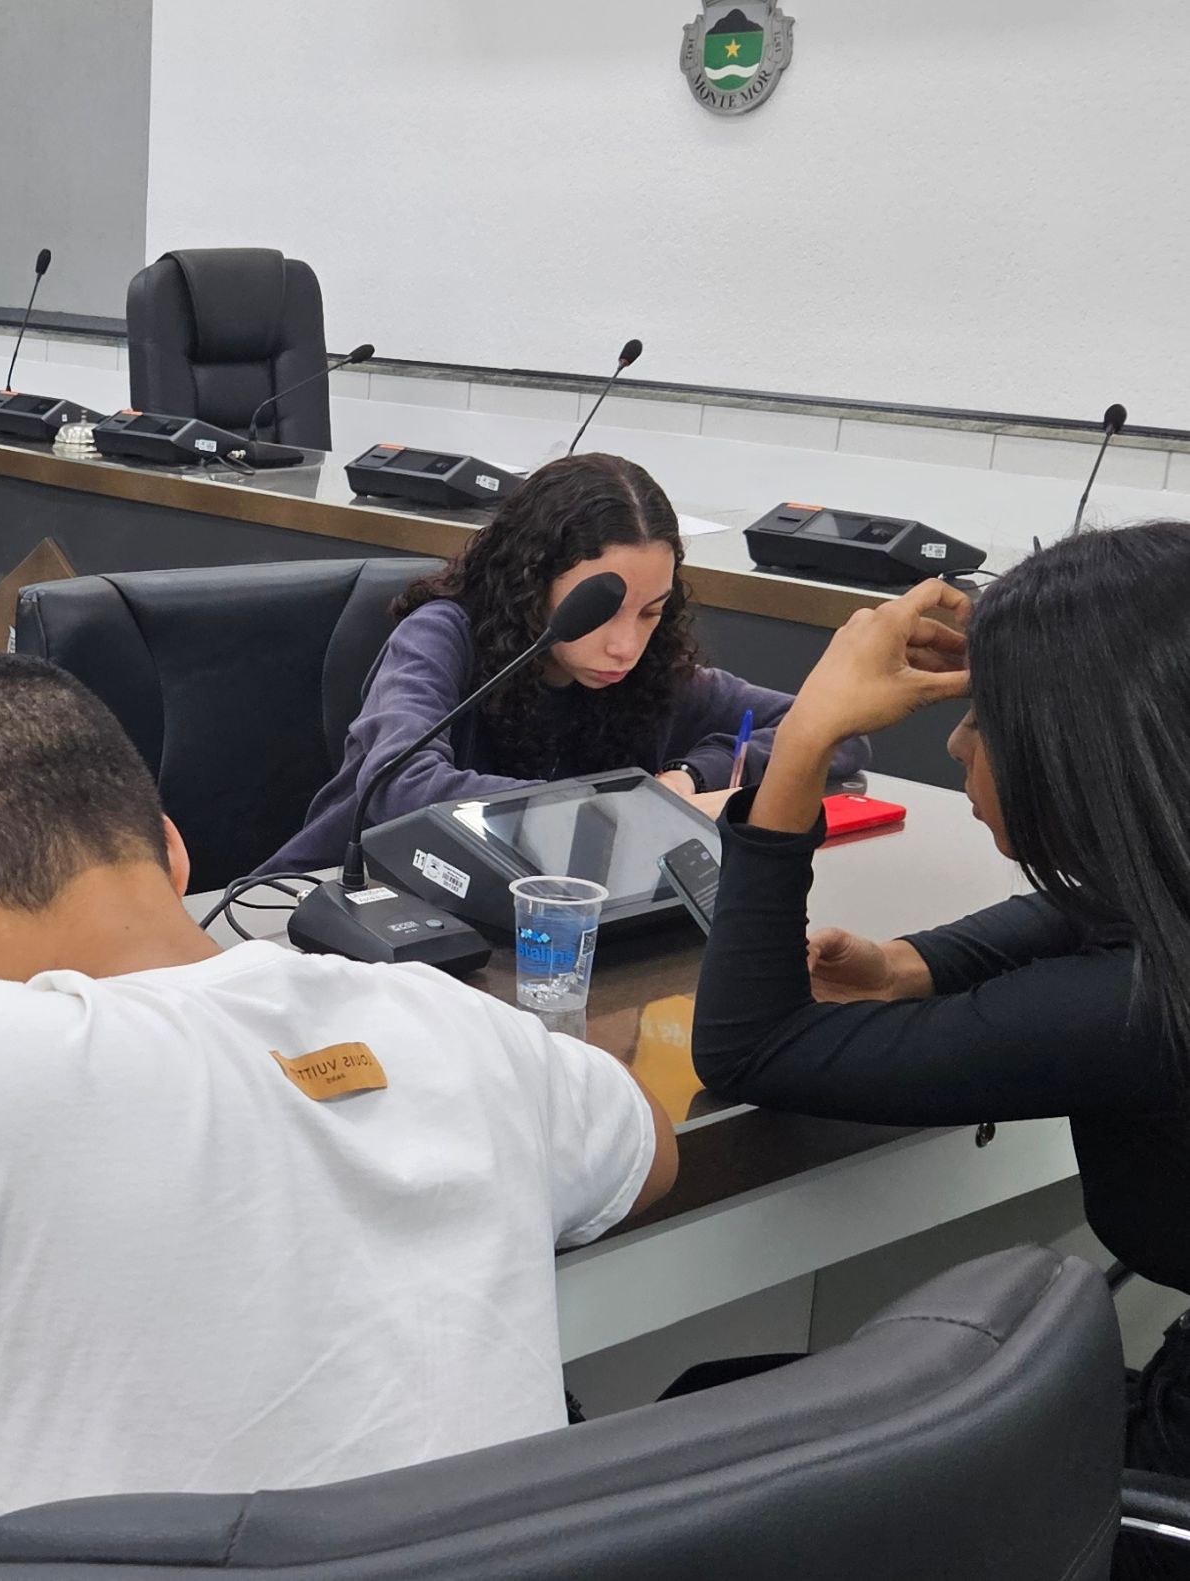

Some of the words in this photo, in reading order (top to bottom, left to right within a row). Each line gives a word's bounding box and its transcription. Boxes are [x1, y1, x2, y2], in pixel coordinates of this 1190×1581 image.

[693, 73, 737, 108] MONTE
[740, 70, 771, 102] MOR
[416, 853, 425, 866] 11
